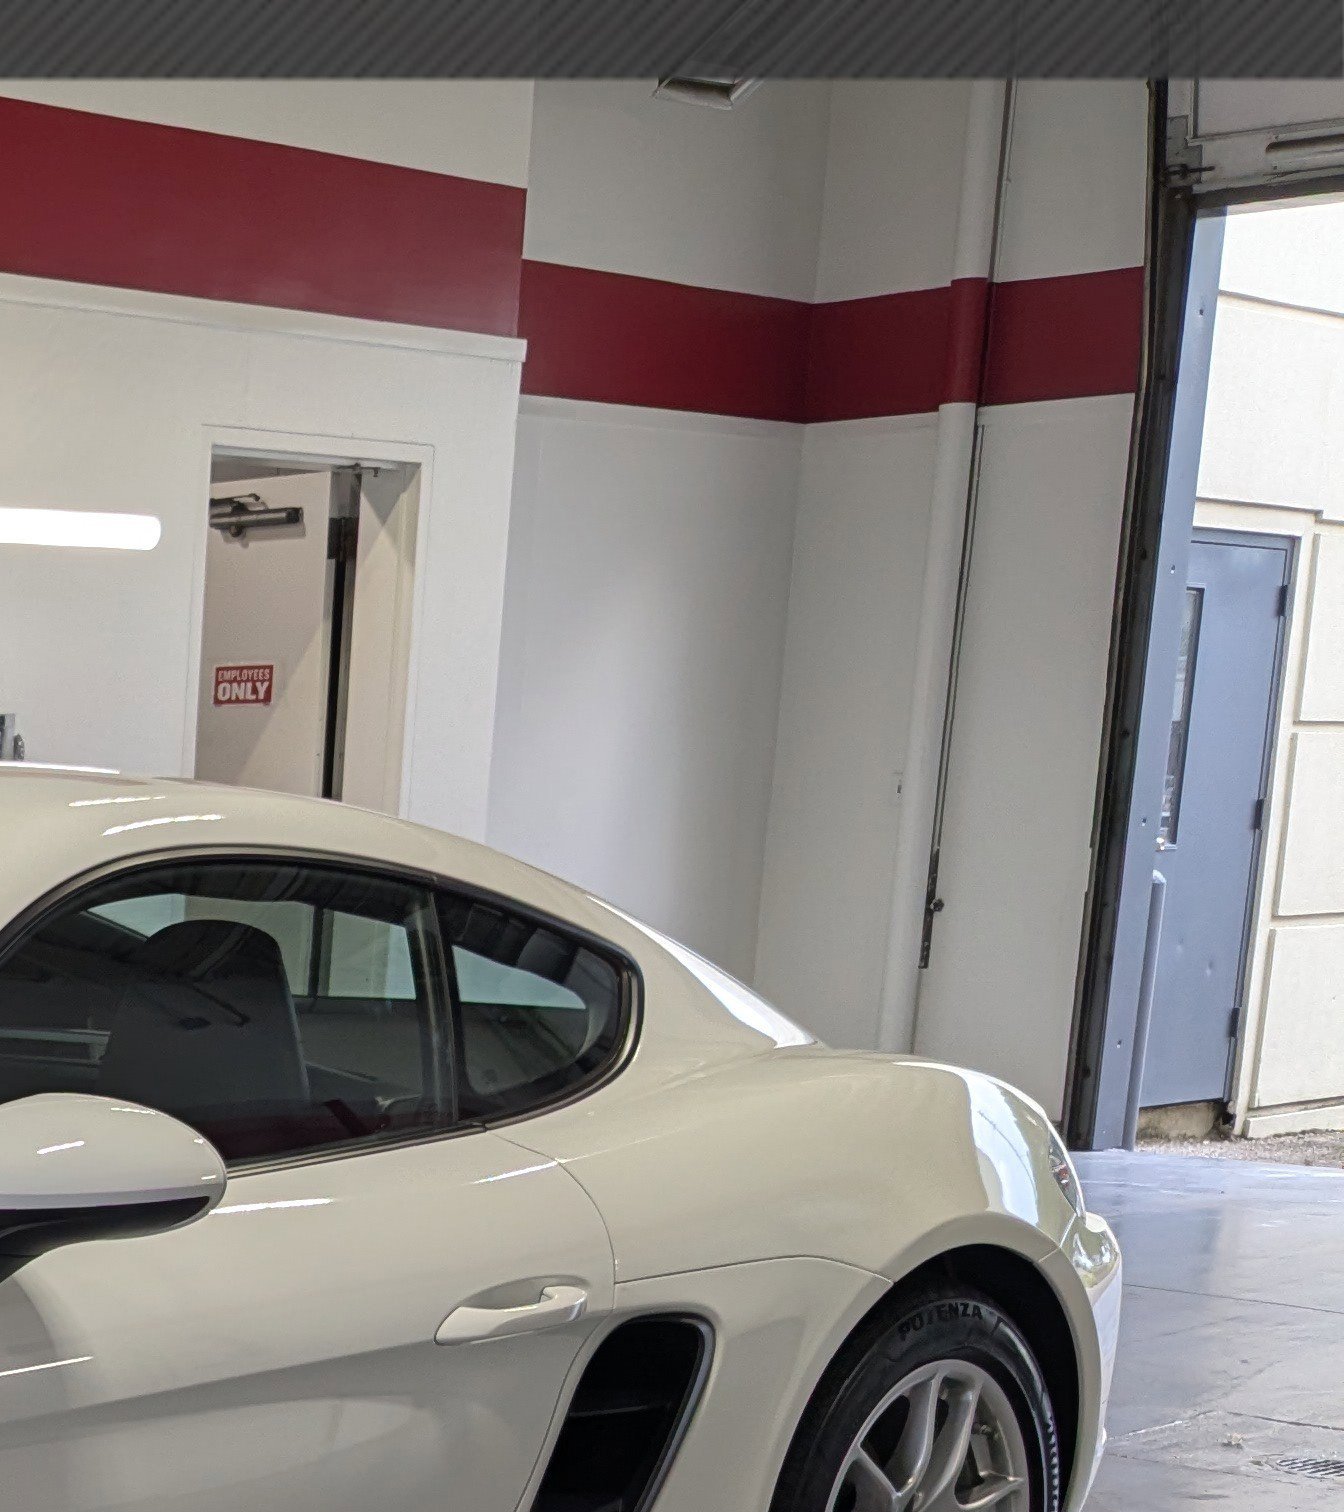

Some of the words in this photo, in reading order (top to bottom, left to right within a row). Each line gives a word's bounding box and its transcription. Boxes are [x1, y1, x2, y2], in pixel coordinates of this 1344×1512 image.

[218, 669, 270, 681] EMPLOYEES
[217, 682, 269, 701] ONLY
[898, 1302, 983, 1342] POTENZA
